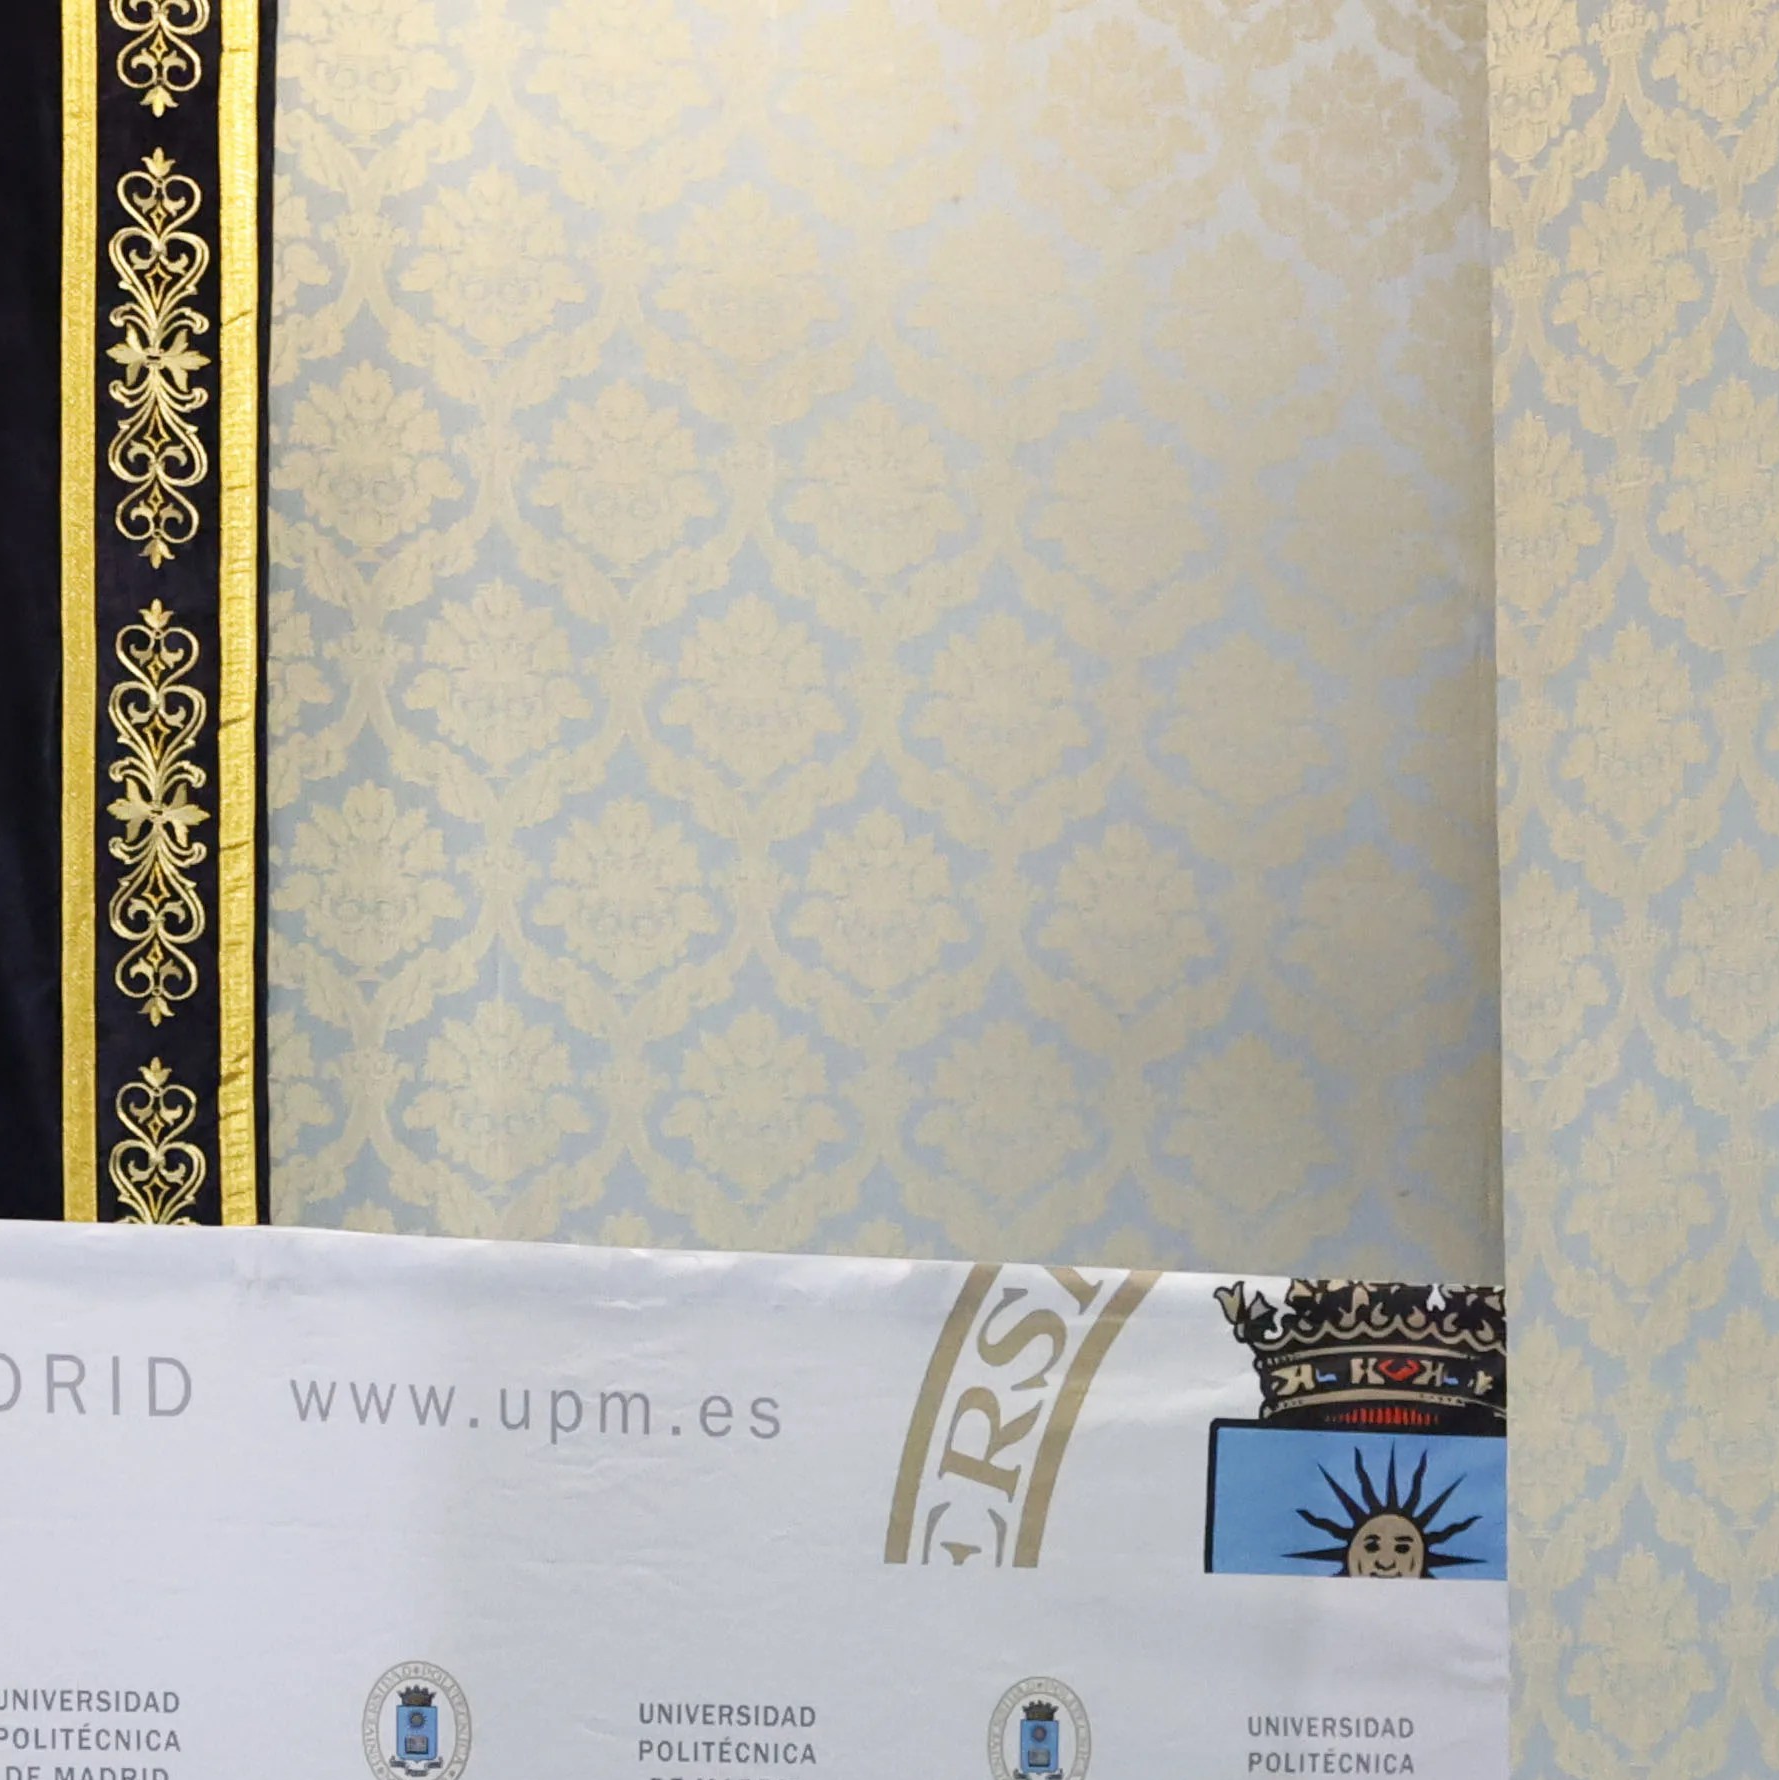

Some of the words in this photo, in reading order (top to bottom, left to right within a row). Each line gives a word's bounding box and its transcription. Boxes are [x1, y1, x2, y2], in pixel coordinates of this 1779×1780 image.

[291, 1380, 780, 1445] www.upm.es
[640, 1703, 815, 1727] UNIVERSIDAD
[1248, 1716, 1413, 1738] UNIVERSIDAD
[639, 1737, 816, 1764] POLITÉCNICA
[1248, 1747, 1414, 1775] POLITÉCNICA
